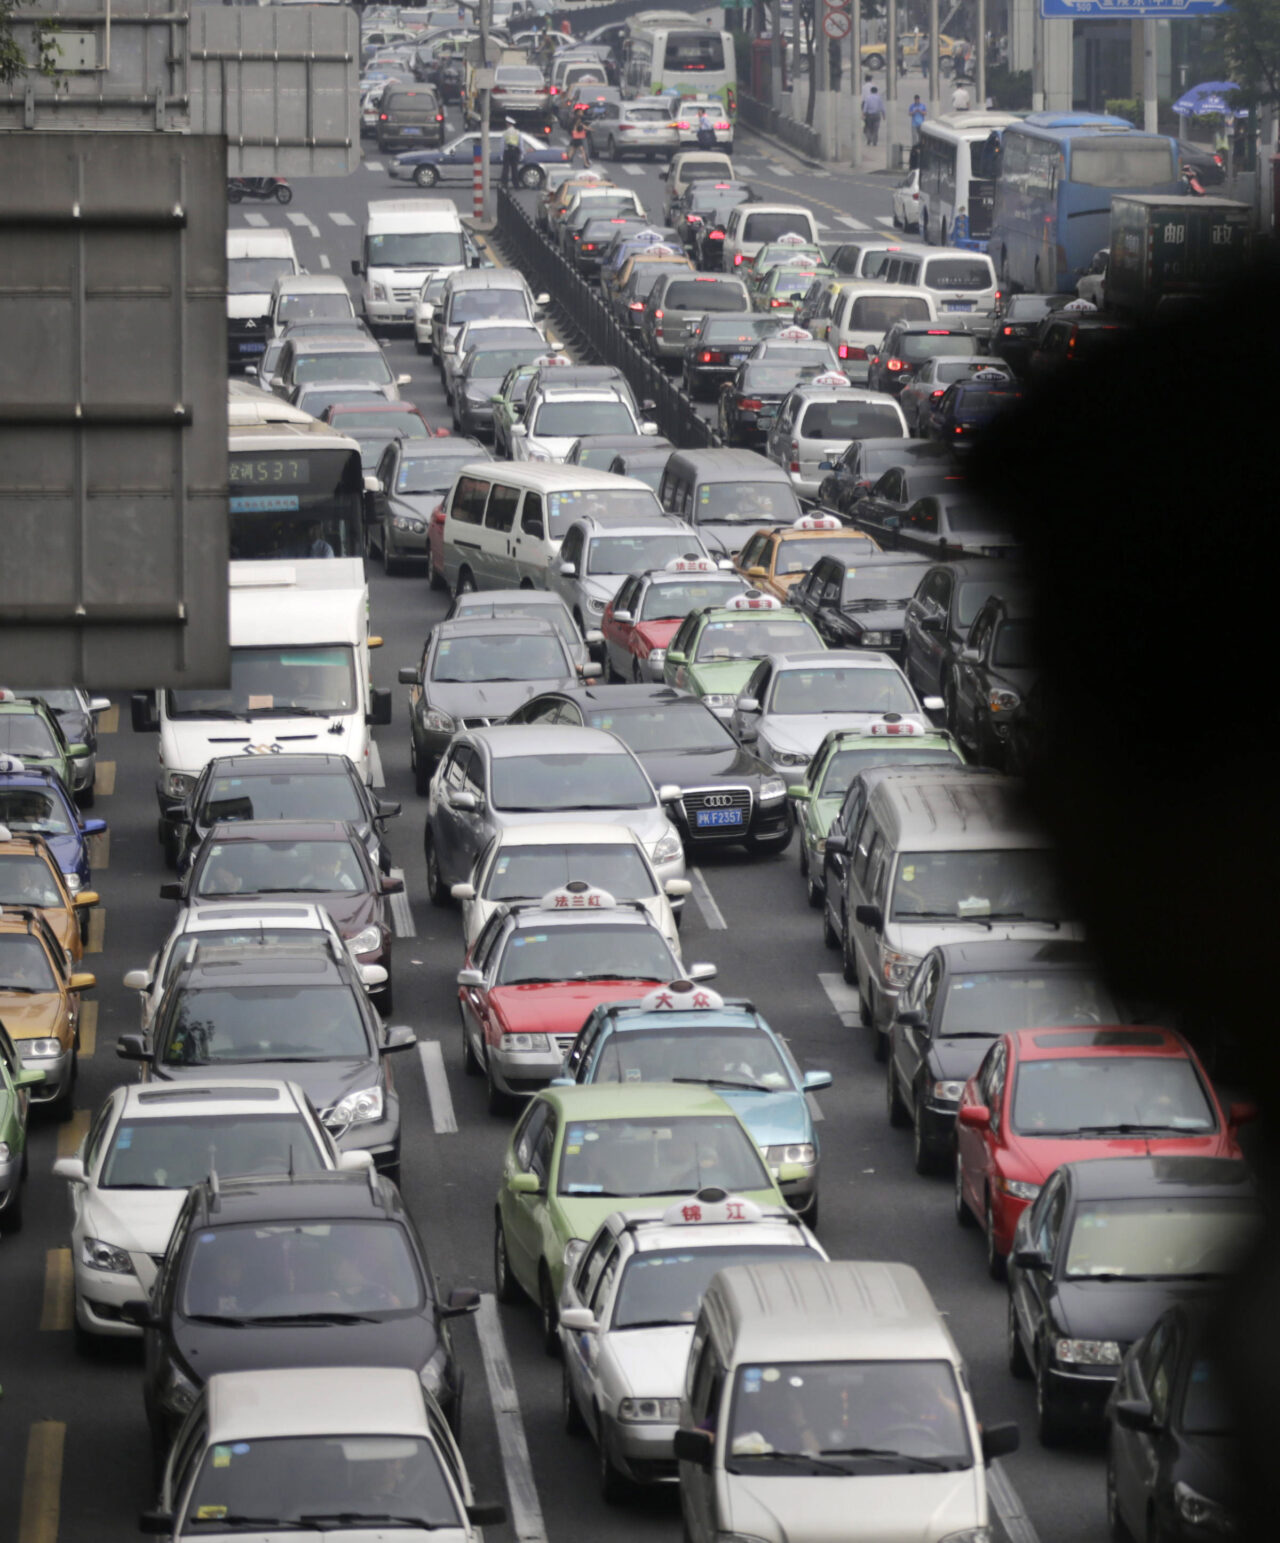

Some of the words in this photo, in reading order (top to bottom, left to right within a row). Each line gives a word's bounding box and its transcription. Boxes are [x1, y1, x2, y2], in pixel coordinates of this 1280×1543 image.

[1163, 222, 1233, 245] 邮政
[655, 992, 710, 1009] 大众
[681, 1203, 747, 1222] 锦江
